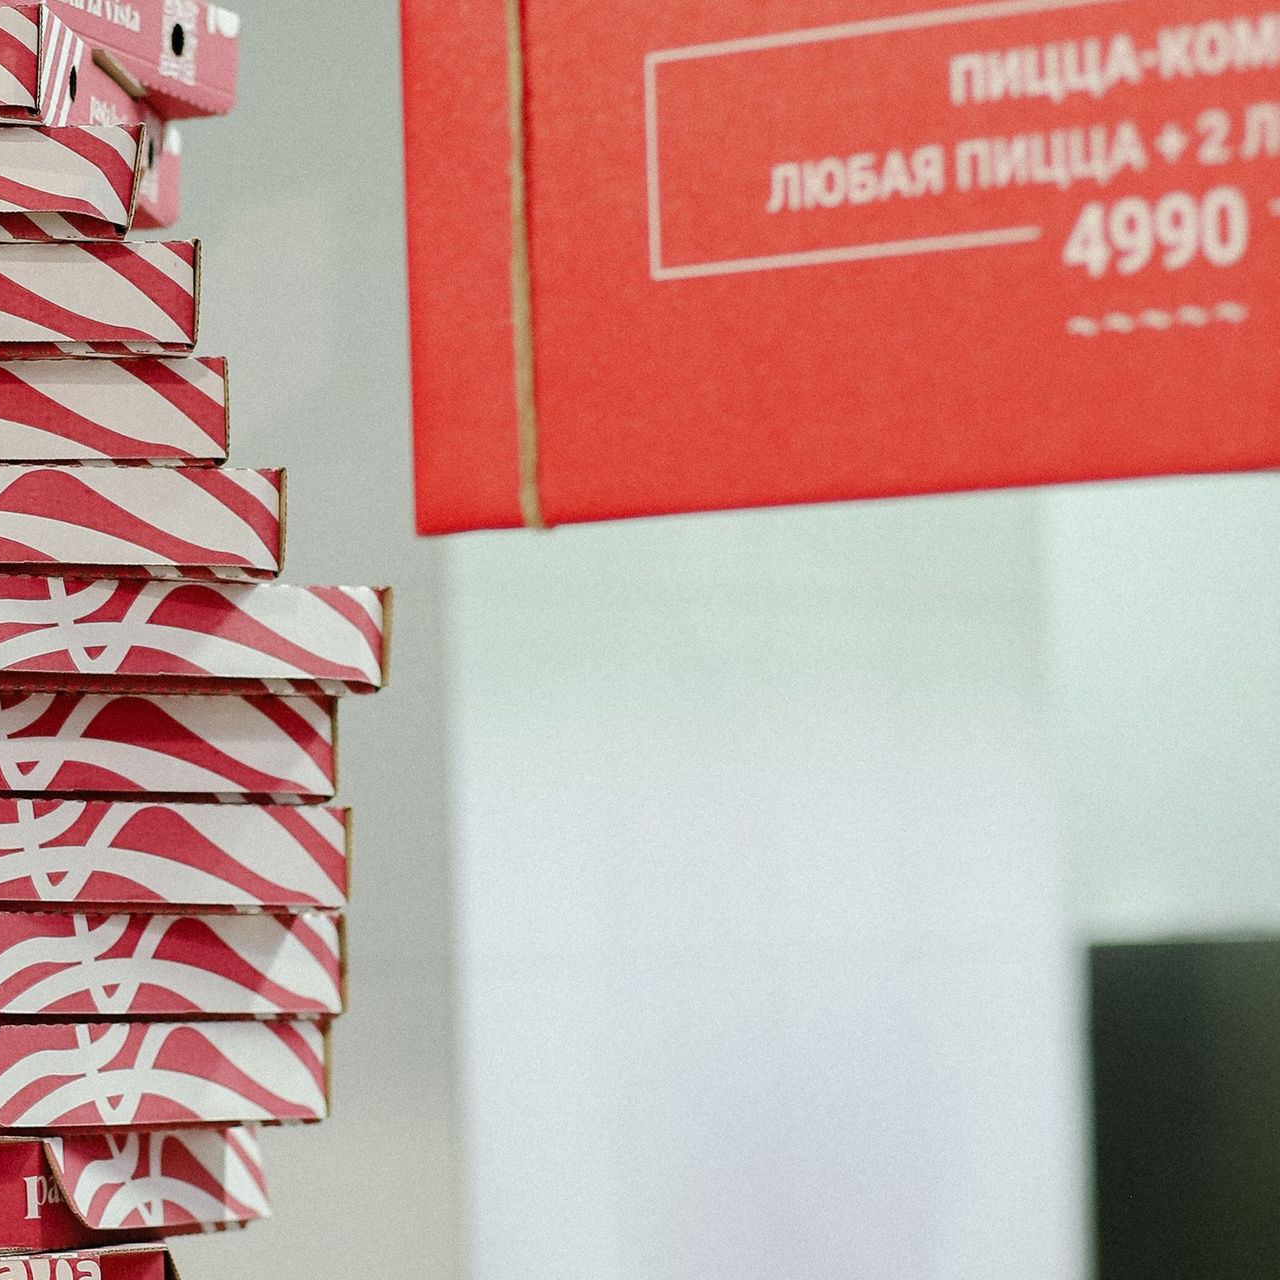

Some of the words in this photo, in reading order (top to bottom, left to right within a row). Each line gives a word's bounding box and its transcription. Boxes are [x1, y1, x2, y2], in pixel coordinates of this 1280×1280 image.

[949, 11, 1280, 107] ПИЦЦА-КОМ
[766, 143, 945, 215] ЛЮБАЯ
[956, 120, 1148, 193] ПИЦЦА
[1154, 122, 1188, 164] +
[1195, 107, 1231, 166] 2
[1062, 185, 1250, 278] 4990
